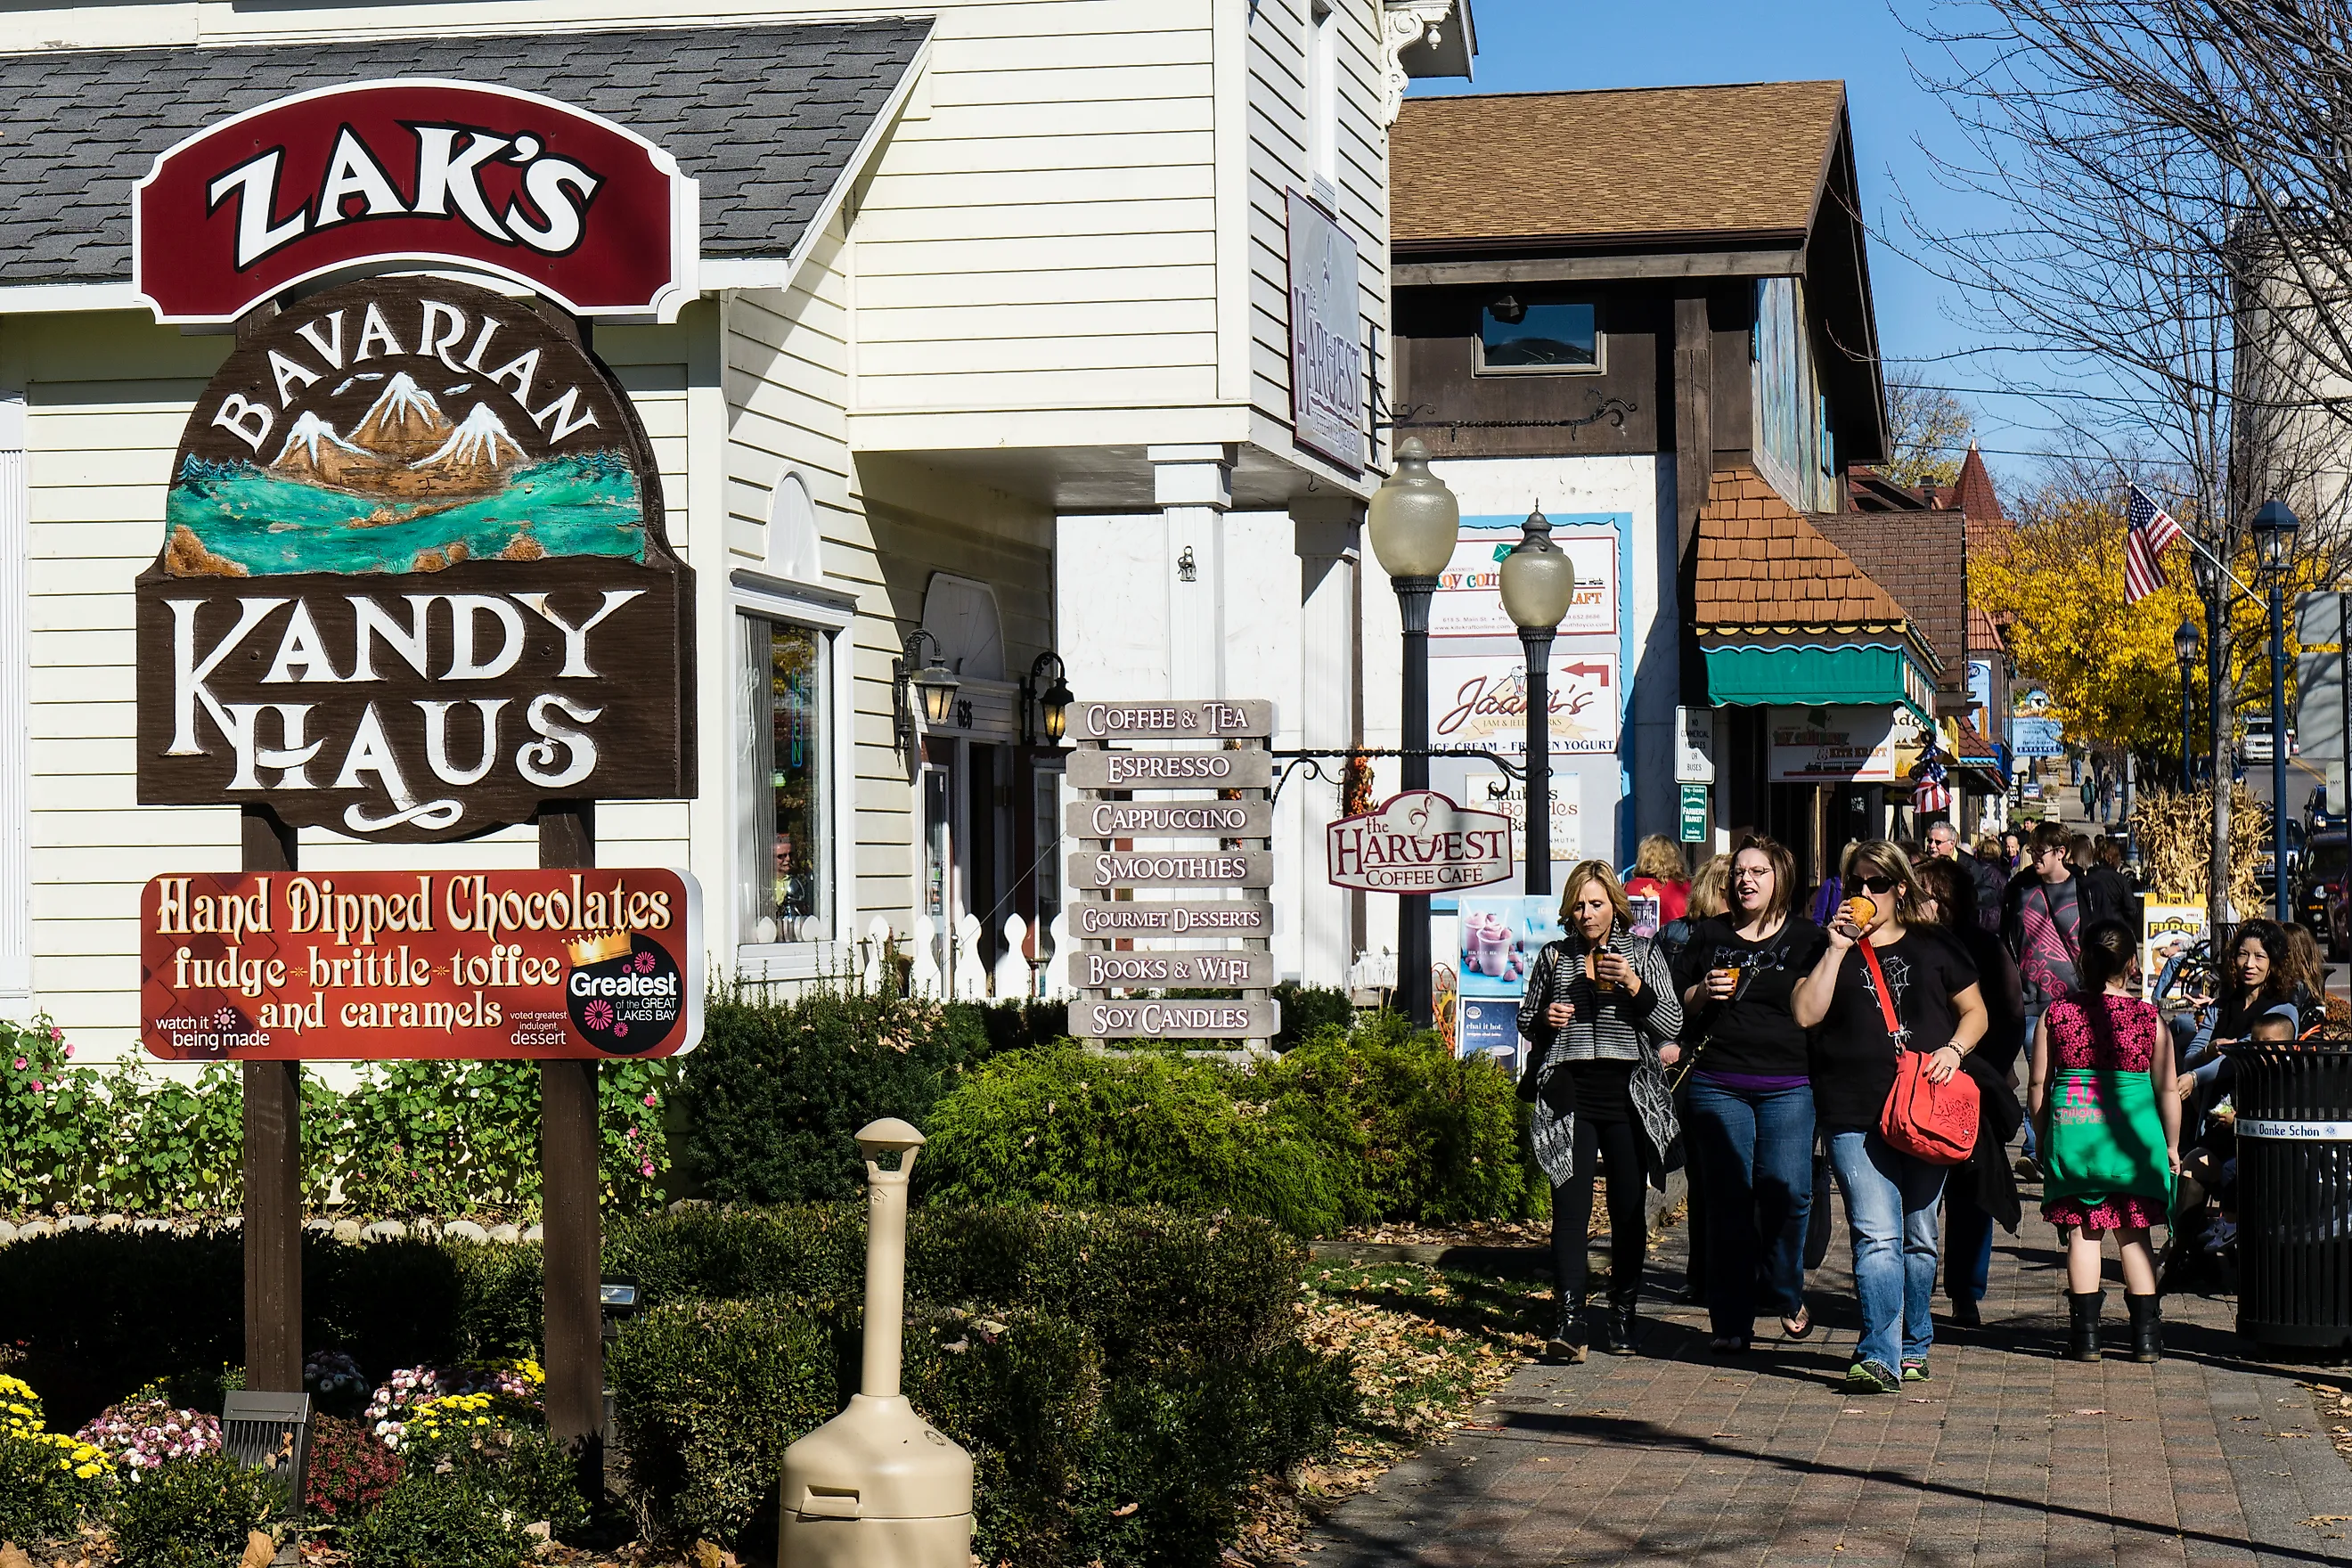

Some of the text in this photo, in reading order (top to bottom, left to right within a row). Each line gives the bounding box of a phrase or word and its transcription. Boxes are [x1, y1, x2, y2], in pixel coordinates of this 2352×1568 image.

[208, 125, 600, 268] ZAK'S
[210, 299, 600, 453] BAVARIAN
[1569, 592, 1602, 605] AFT
[159, 588, 649, 757] KANDY
[1437, 674, 1595, 736] Jaai's
[1086, 702, 1249, 737] COFFEE & TEA
[1482, 719, 1500, 727] JAM
[1510, 719, 1526, 727] JELL
[1691, 718, 1699, 727] NO
[1680, 730, 1710, 739] COMMERCIAL
[1684, 740, 1706, 749] VEHICLES
[1454, 741, 1497, 752] CREAM
[1564, 740, 1614, 751] YOGURT
[1691, 752, 1698, 760] OR
[224, 692, 607, 832] HAUS
[1107, 755, 1230, 784] ESPRESSO
[1686, 763, 1703, 772] BUSES
[1091, 804, 1247, 837] CAPPUCCINO
[1682, 806, 1705, 816] FARMERS
[1685, 815, 1703, 823] MARKET
[1365, 815, 1390, 836] the
[1334, 829, 1506, 877] HARVEST
[1095, 853, 1247, 886] SMOOTHIES
[1366, 865, 1484, 886] COFFEE CAFÉ
[155, 872, 673, 946] Hand Dipped Chocolates
[1082, 907, 1262, 933] GOURMET DESSERTS
[173, 943, 562, 998] fudge brittle toffee
[1088, 955, 1168, 986] BOOKS
[1173, 961, 1191, 979] &
[570, 971, 677, 997] Greatest
[257, 990, 503, 1037] and caramels
[616, 998, 677, 1009] of the GREAT
[155, 1016, 210, 1030] watch it
[510, 1010, 568, 1021] voted greatest
[617, 1009, 677, 1021] LAKES BAY
[1091, 1004, 1249, 1035] SOY CANDLES
[172, 1029, 270, 1051] being made
[510, 1030, 567, 1045] dessert
[2258, 1123, 2320, 1137] Danke Schön
